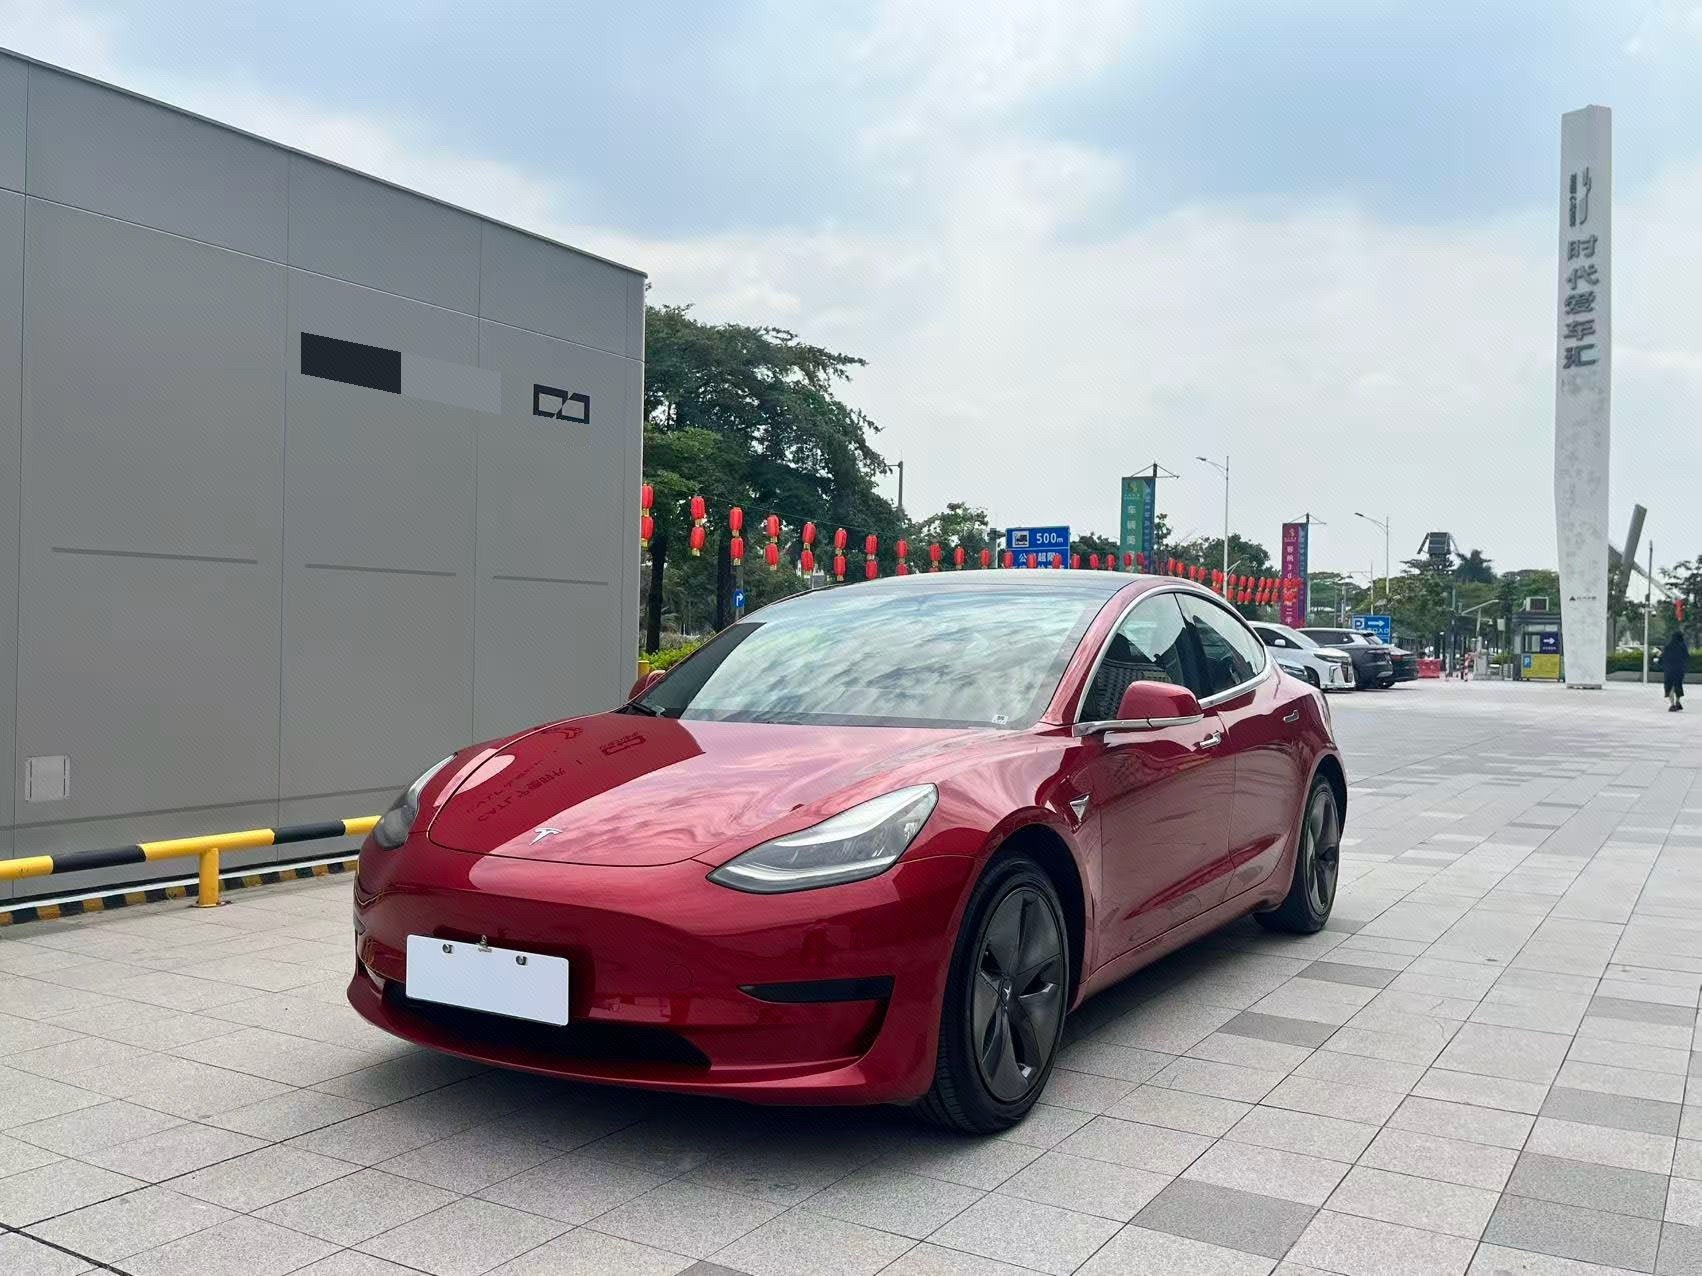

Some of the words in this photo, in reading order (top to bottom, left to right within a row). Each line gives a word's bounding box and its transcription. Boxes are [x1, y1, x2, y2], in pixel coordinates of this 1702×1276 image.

[1036, 532, 1064, 544] 500m
[1018, 551, 1056, 562] 公超限
